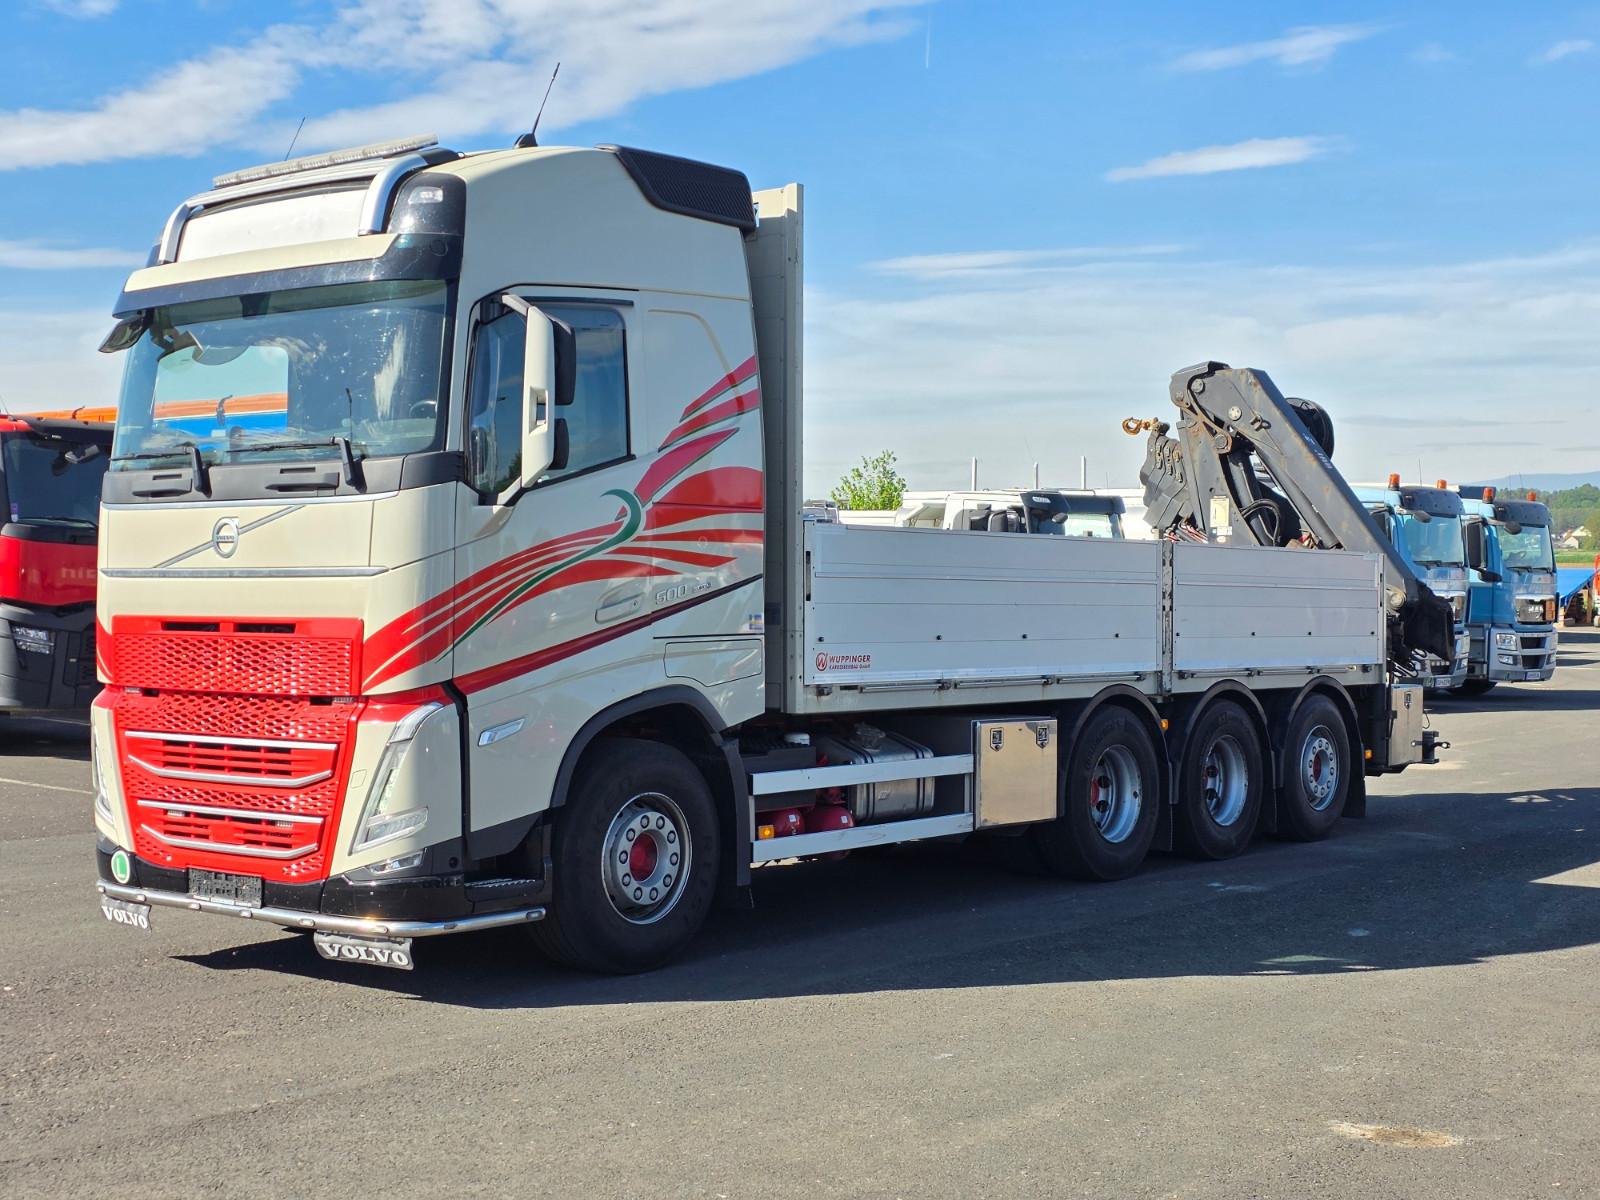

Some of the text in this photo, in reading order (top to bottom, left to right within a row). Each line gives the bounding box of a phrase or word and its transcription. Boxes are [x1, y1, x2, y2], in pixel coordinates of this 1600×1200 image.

[655, 584, 687, 605] 500
[829, 655, 871, 663] WUPPINGER
[101, 906, 148, 929] VOLVO
[319, 942, 409, 966] VOLVO
